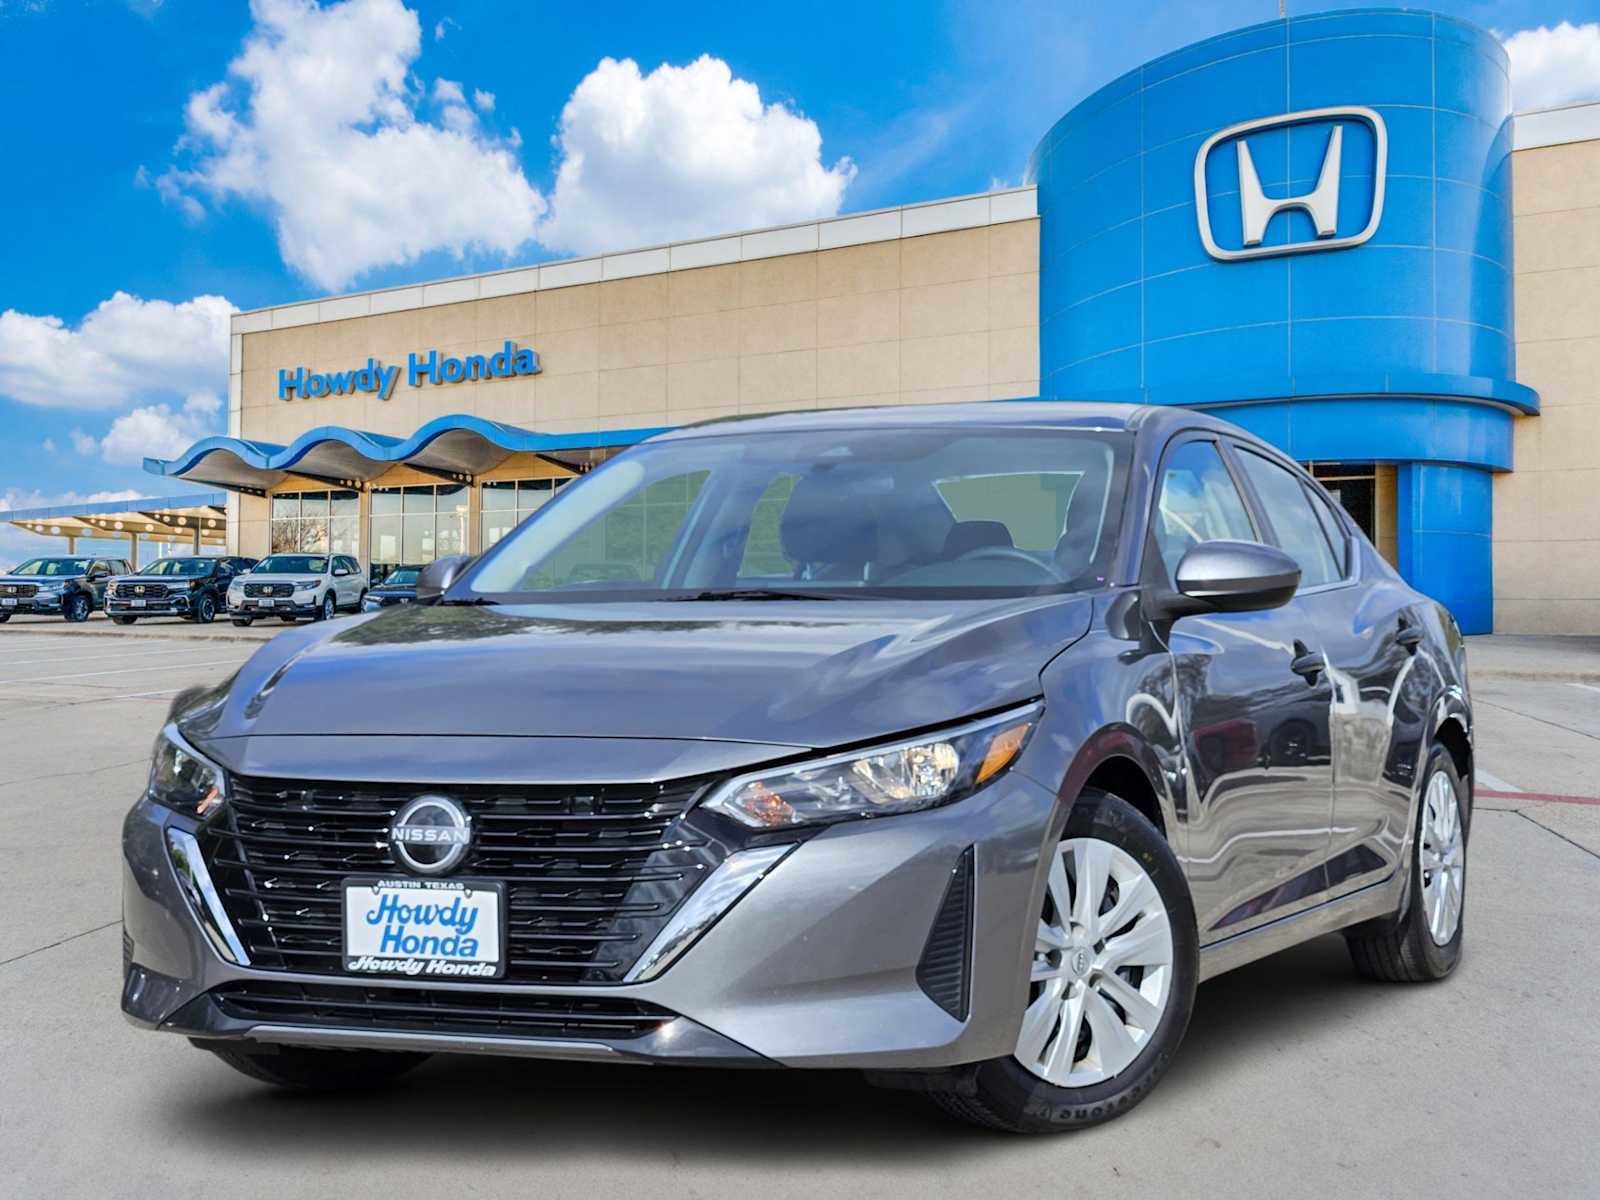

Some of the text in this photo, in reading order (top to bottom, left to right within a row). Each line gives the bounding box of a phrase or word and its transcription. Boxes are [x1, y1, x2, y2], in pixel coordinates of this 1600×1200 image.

[278, 340, 542, 400] Howdy Honda
[391, 828, 467, 842] NISSAN
[377, 880, 464, 890] AUSTIN TEXAS
[367, 894, 479, 935] Howdy
[380, 924, 479, 957] Honda
[349, 956, 497, 977] Howdy Honda
